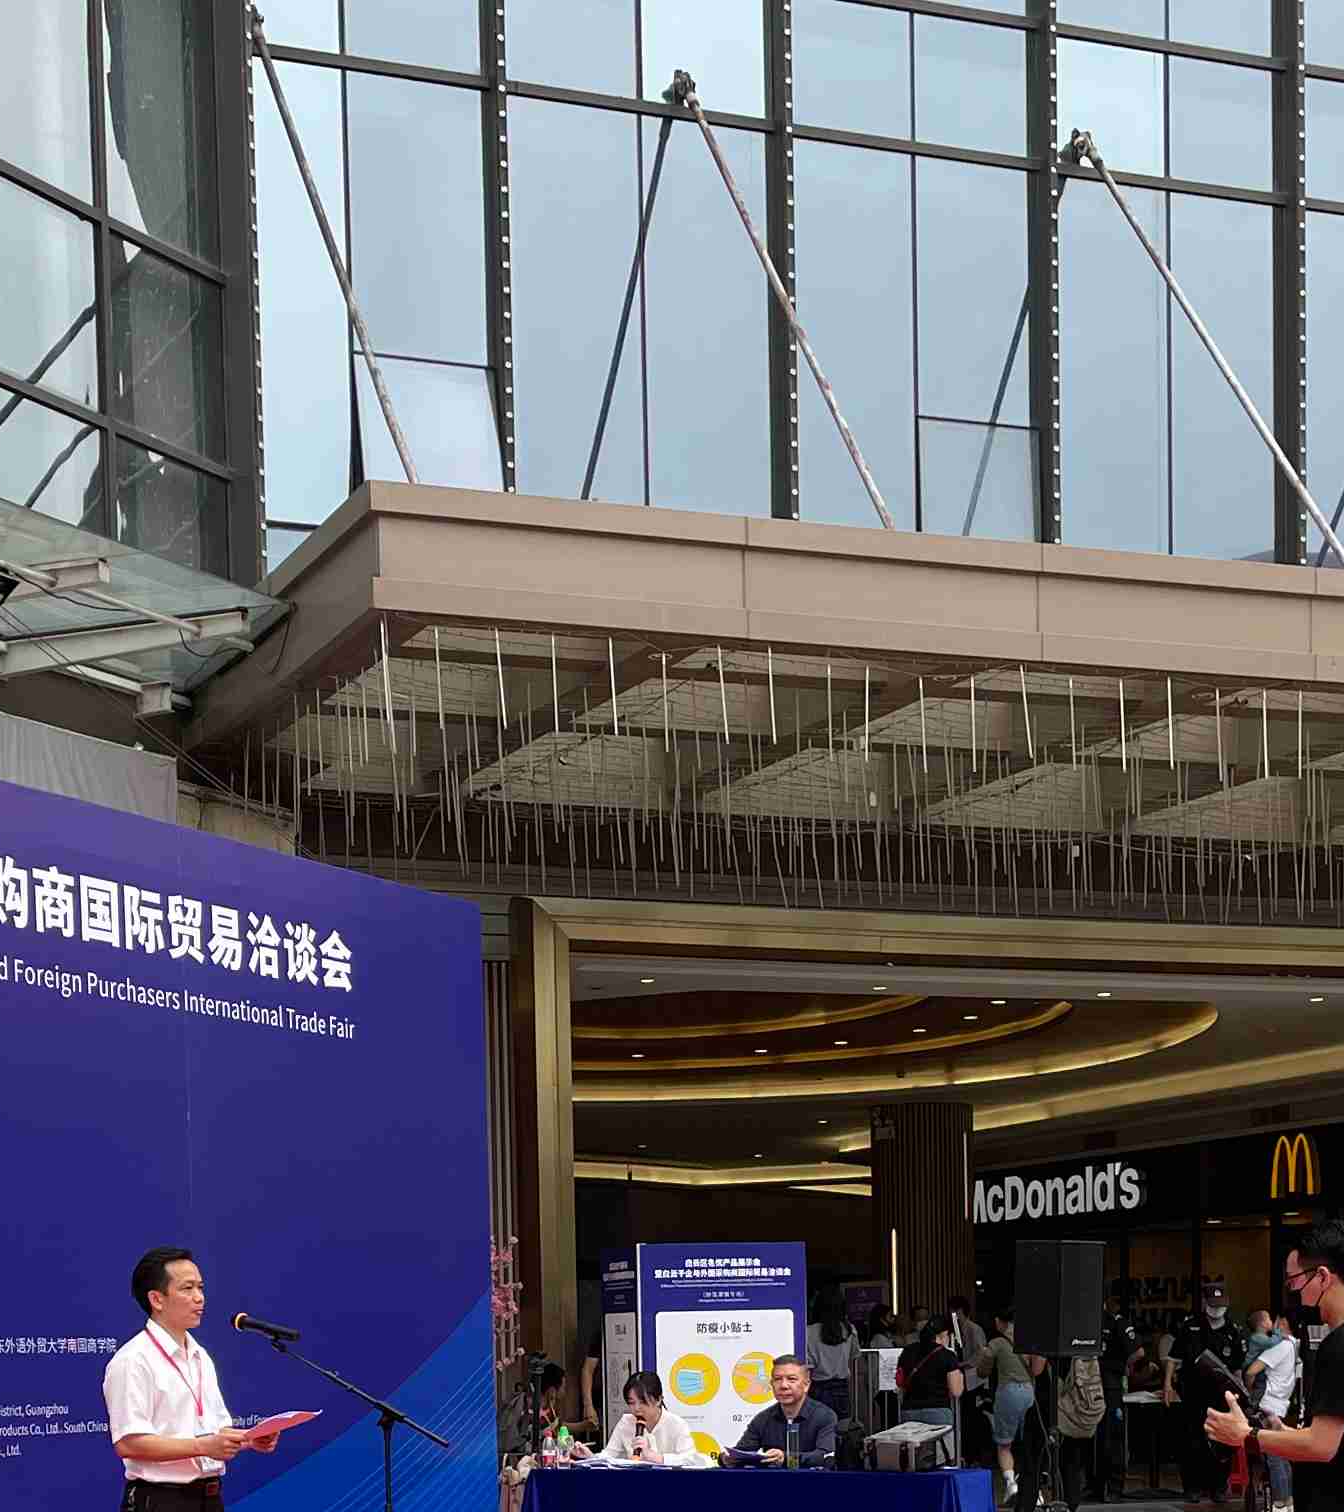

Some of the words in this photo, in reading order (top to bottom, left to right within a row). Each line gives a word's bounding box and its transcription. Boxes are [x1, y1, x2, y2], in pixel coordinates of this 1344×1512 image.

[14, 958, 82, 998] Foreign
[87, 971, 181, 1010] Purchasers
[184, 989, 284, 1028] International
[285, 1007, 326, 1035] Trade
[329, 1015, 355, 1039] Fair
[24, 1403, 69, 1419] Guangzhou
[29, 1423, 45, 1436] Co.,
[63, 1421, 87, 1434] South
[86, 1420, 109, 1433] China
